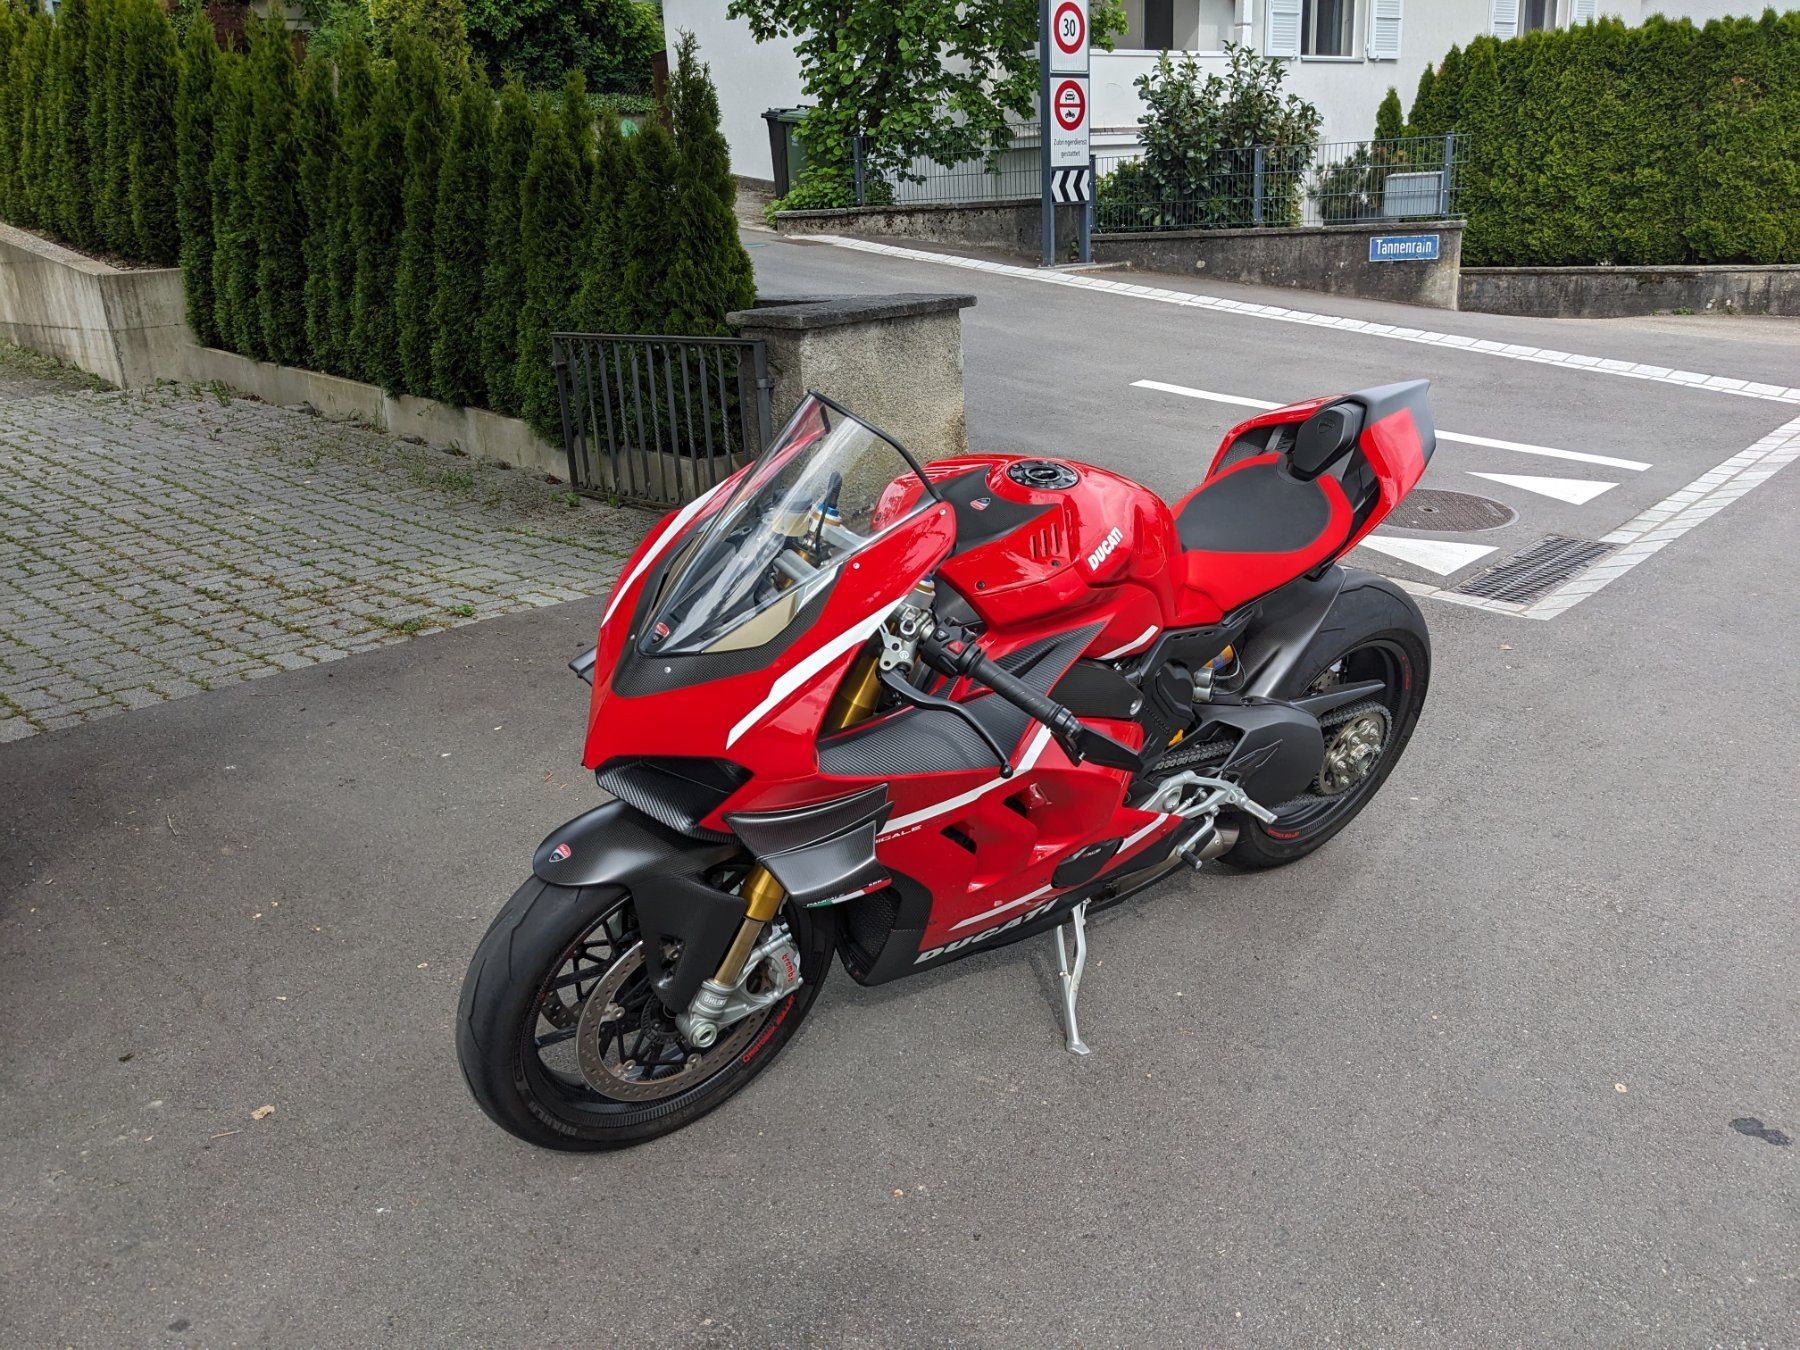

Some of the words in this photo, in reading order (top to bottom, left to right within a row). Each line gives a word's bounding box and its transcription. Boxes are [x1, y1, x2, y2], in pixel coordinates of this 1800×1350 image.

[1063, 18, 1076, 37] 30
[1376, 239, 1432, 255] Tannenrain
[1087, 526, 1124, 571] DUCATI
[913, 897, 1059, 965] DUCATI
